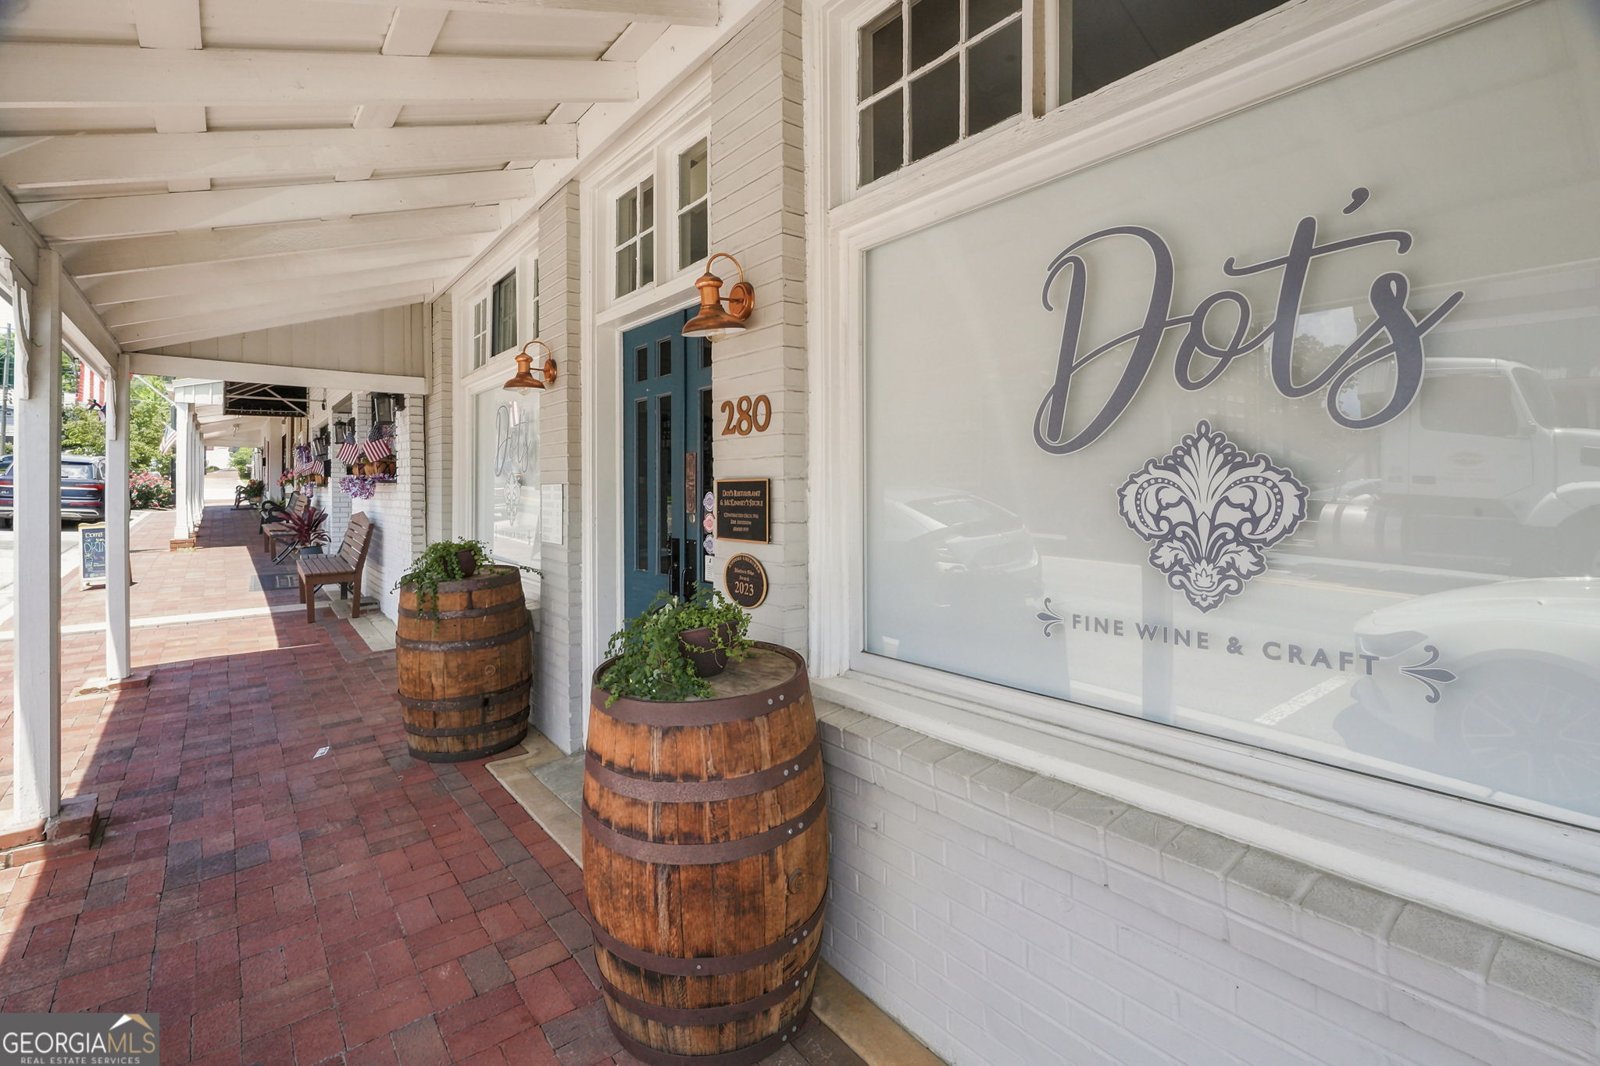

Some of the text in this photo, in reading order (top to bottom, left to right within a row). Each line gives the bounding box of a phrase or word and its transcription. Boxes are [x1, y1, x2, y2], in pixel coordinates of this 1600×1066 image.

[1034, 187, 1465, 456] Dot's
[720, 394, 772, 436] 280
[734, 581, 754, 597] 2023
[1072, 614, 1380, 677] FINE WINE & CRAFT
